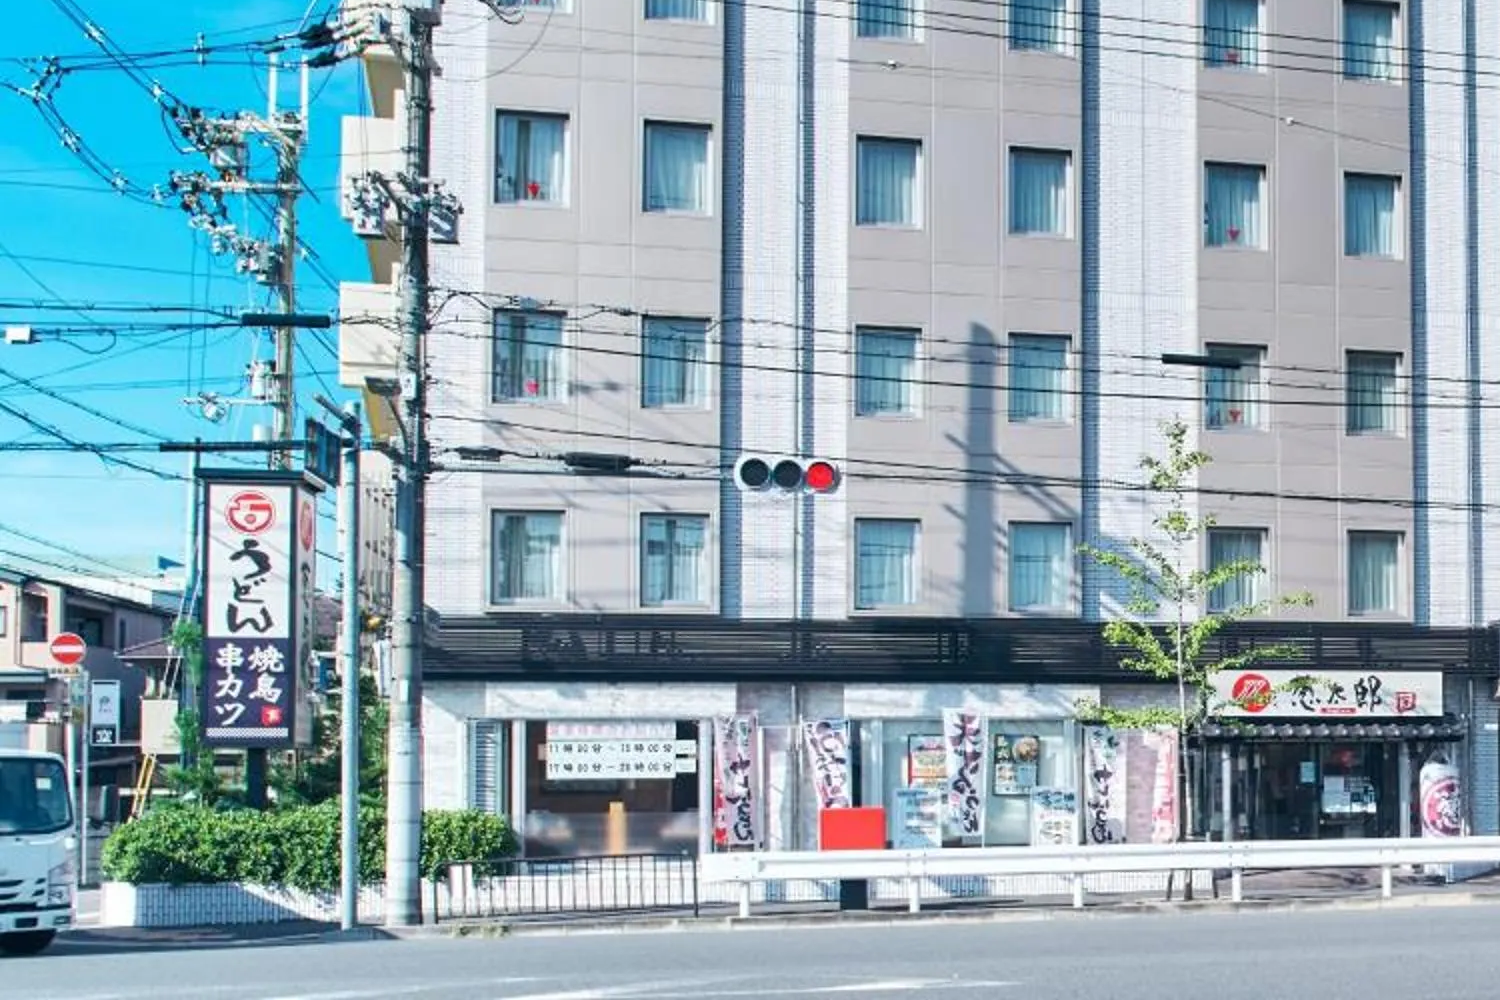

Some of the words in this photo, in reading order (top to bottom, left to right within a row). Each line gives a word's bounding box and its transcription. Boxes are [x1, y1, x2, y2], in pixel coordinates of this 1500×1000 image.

[229, 539, 273, 634] うどん
[214, 643, 246, 726] 串カツ
[248, 644, 285, 703] 焼鳥
